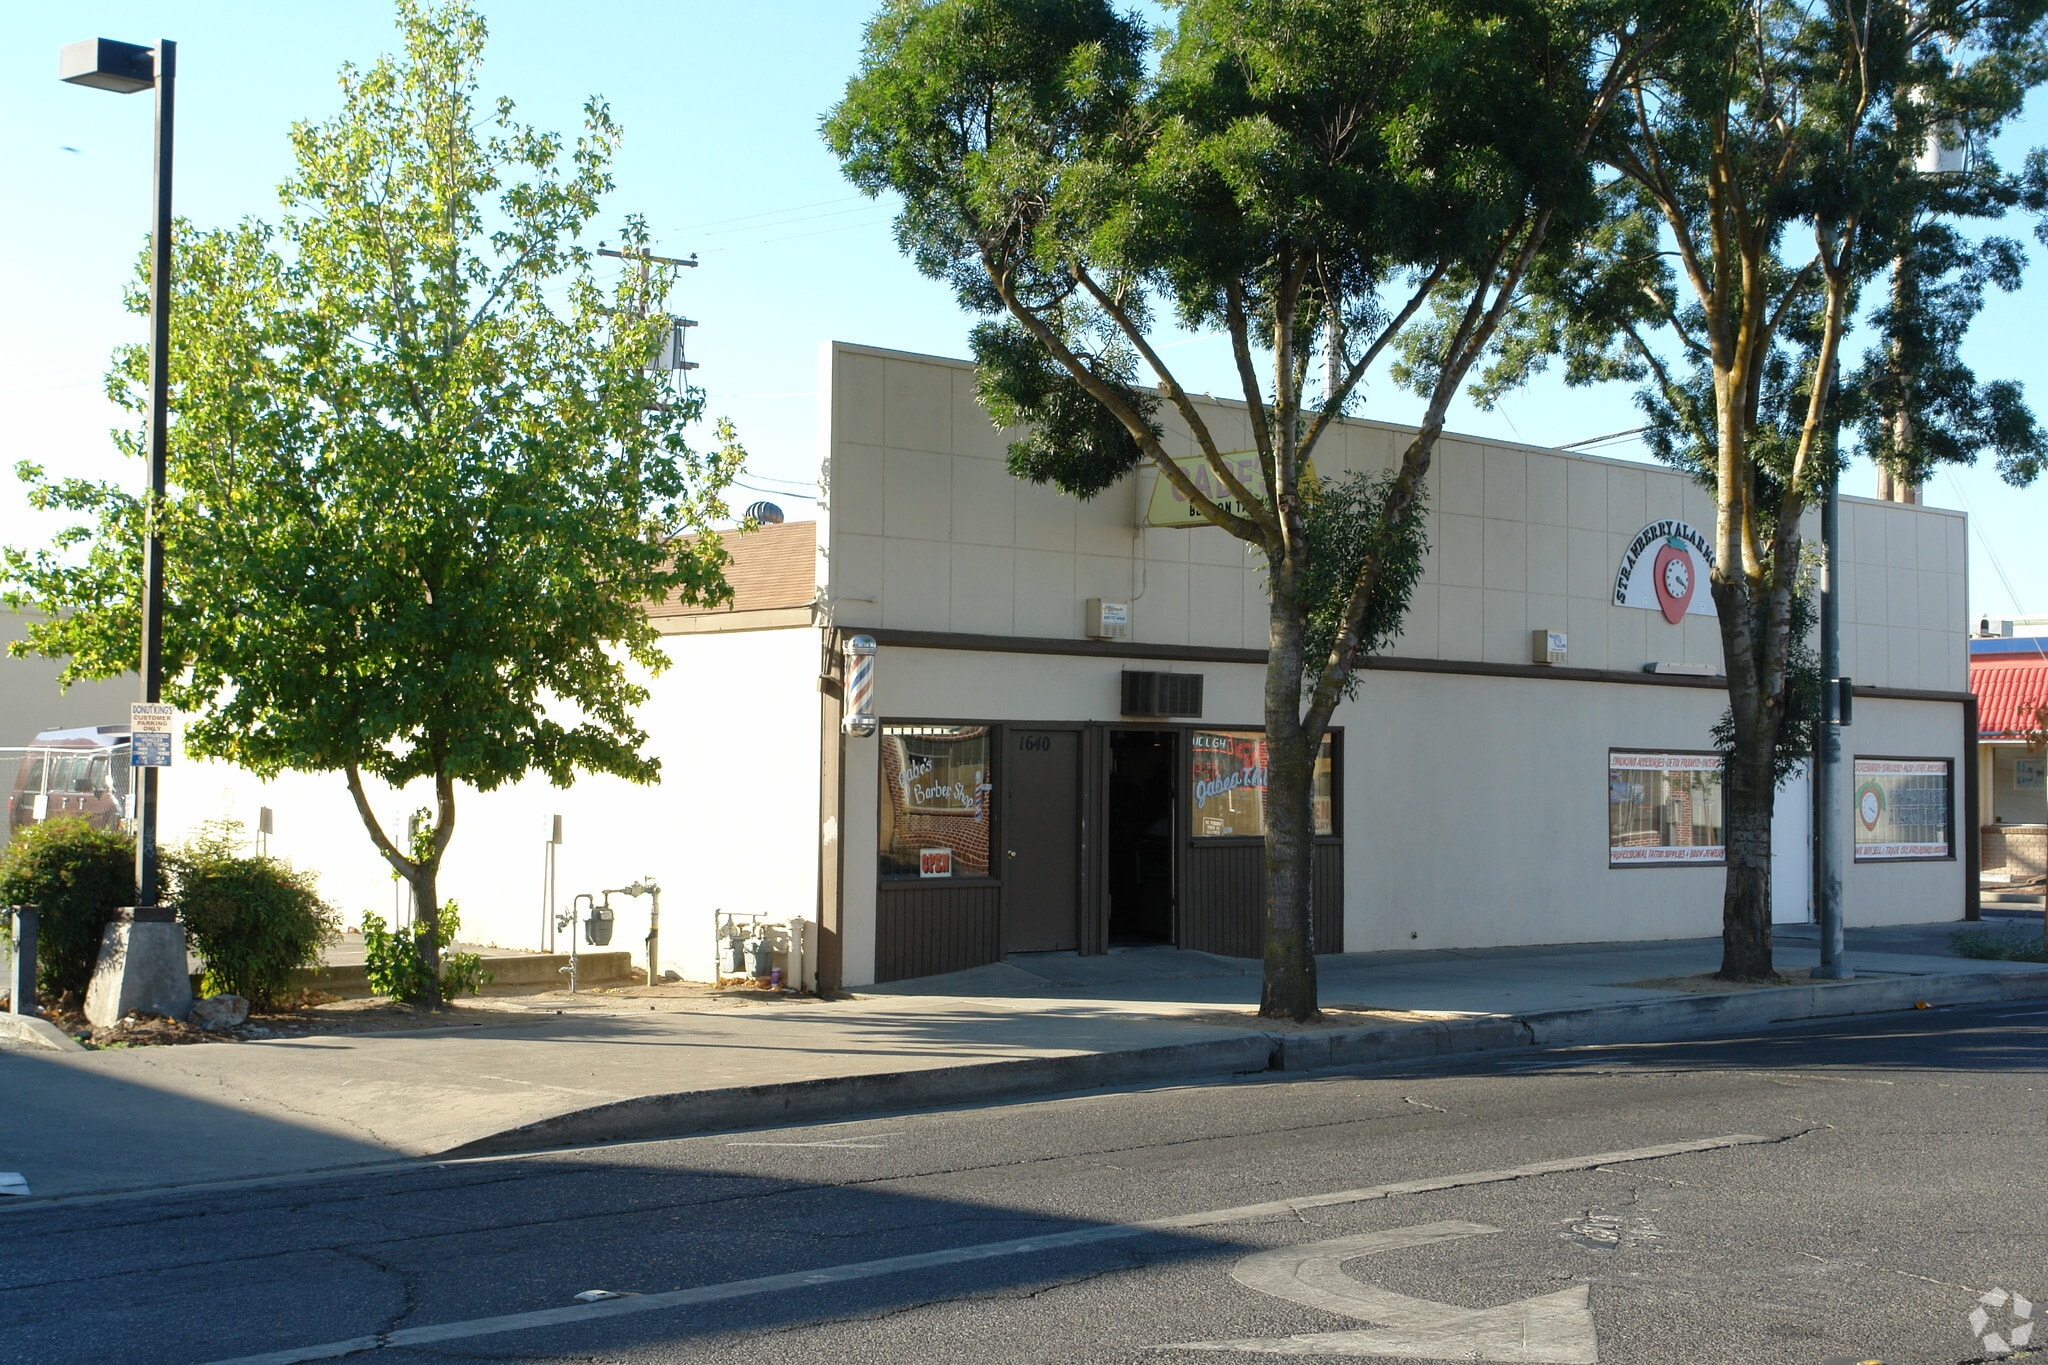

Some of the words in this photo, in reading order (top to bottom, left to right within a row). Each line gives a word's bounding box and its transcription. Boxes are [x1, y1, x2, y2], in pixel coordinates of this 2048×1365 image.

[1616, 520, 1673, 604] STRAWBERRY
[1674, 522, 1714, 563] ALARM
[132, 705, 153, 714] DONUT
[1019, 735, 1050, 751] 1640
[914, 781, 952, 805] Barber
[953, 782, 974, 808] Shop
[921, 852, 950, 874] OPEN
[1689, 849, 1703, 858] BODY
